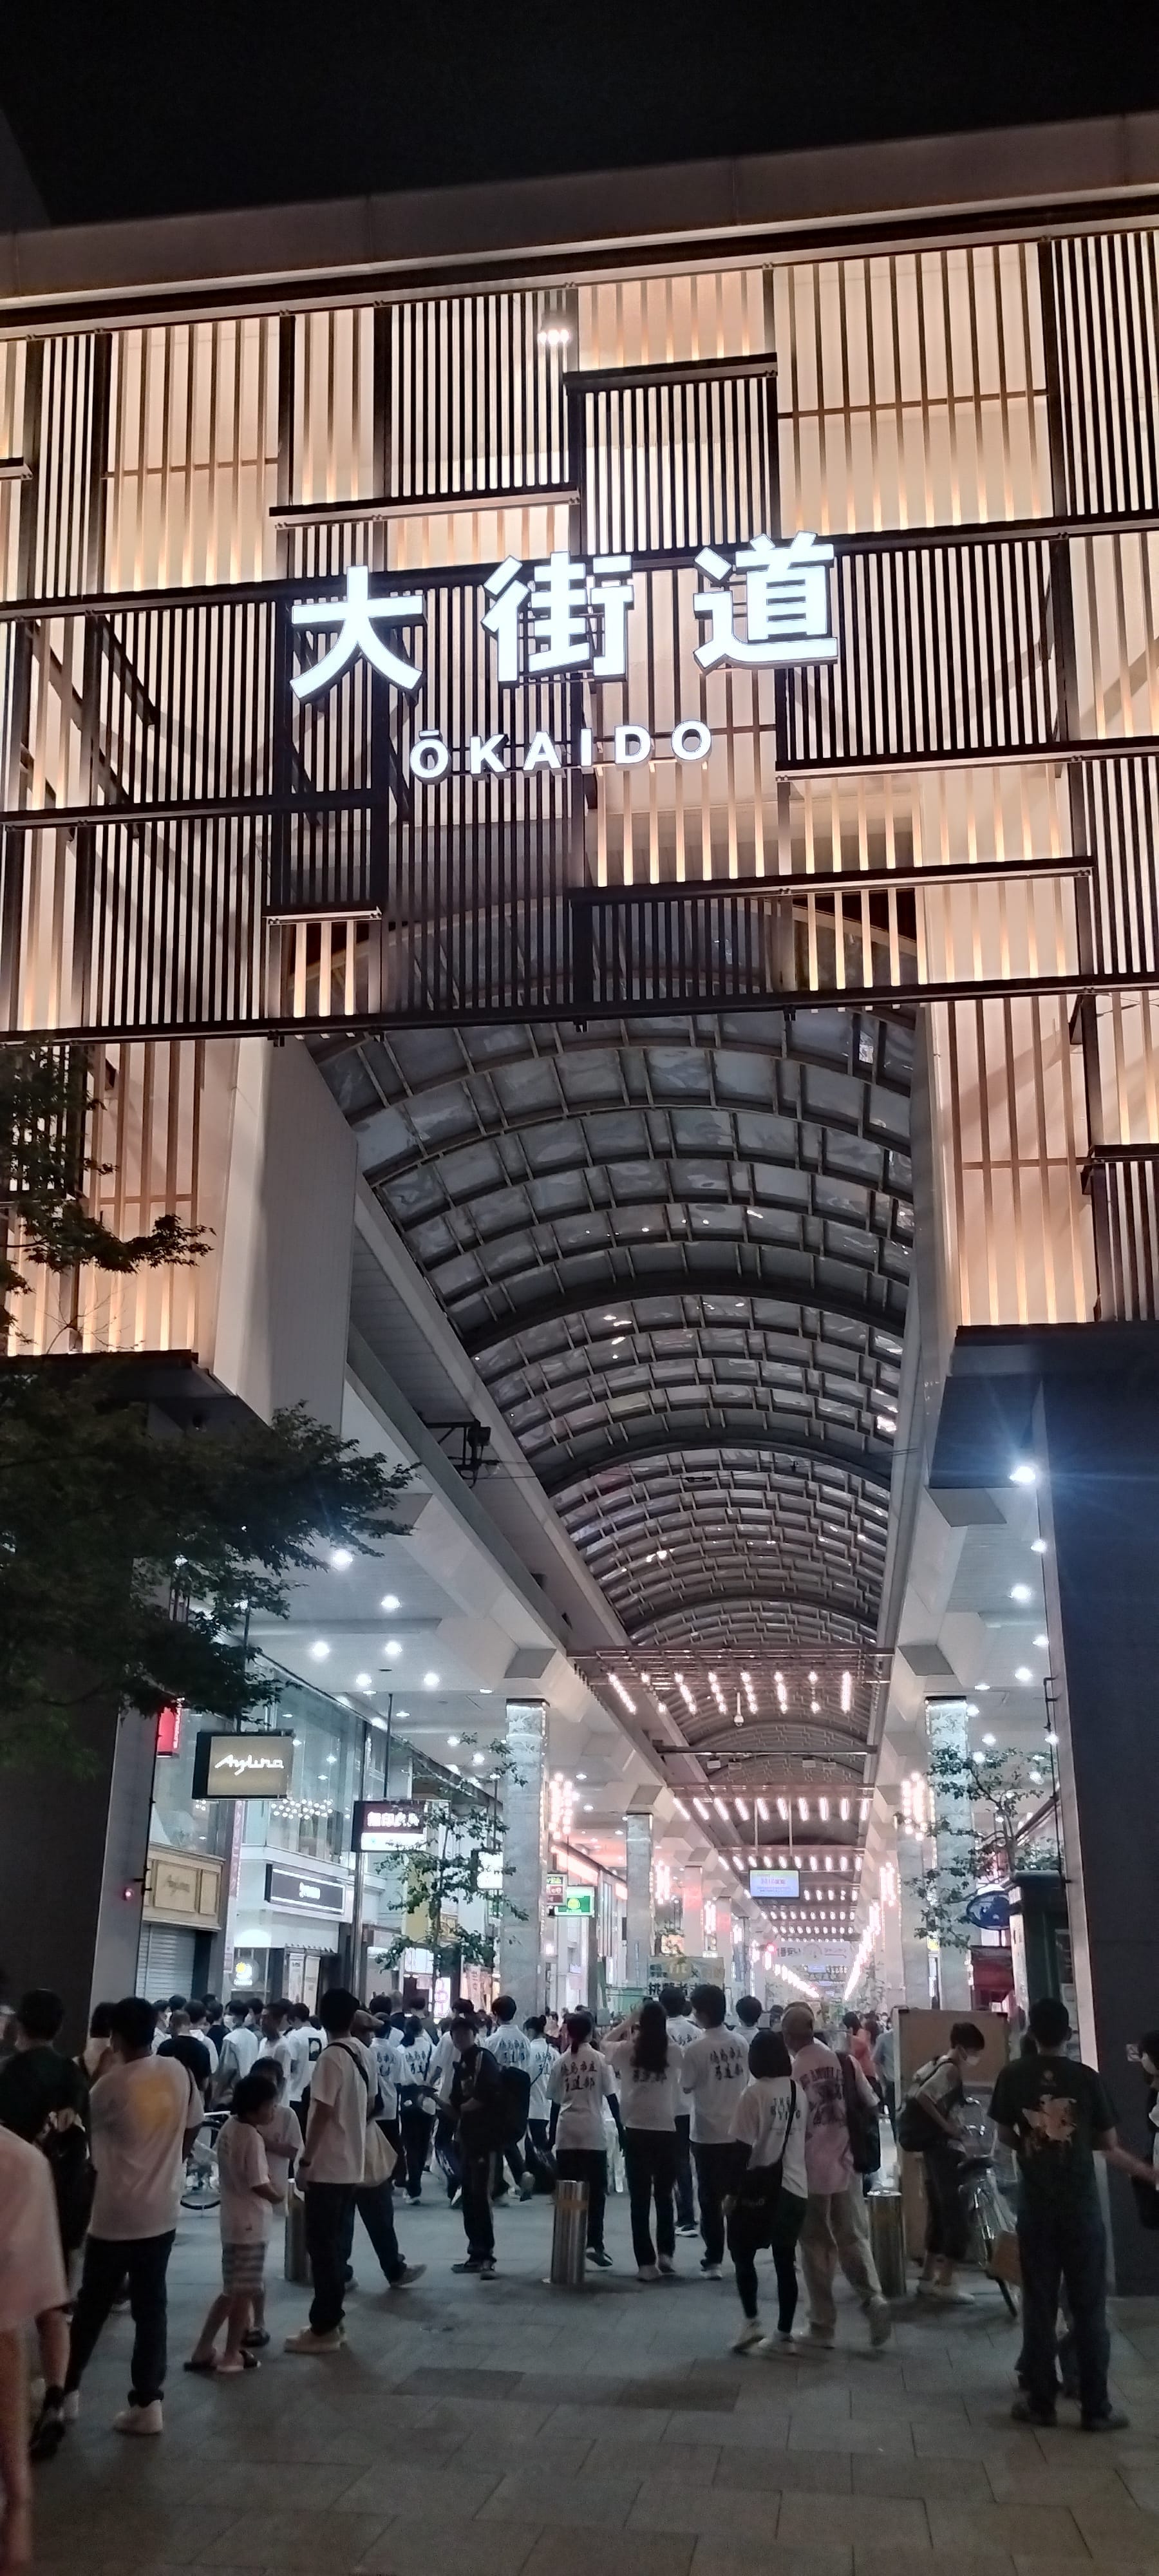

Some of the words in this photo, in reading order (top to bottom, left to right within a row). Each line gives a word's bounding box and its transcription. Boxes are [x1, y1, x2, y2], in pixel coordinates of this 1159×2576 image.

[290, 531, 839, 701] 大街道
[409, 719, 712, 779] ŌKAIDO
